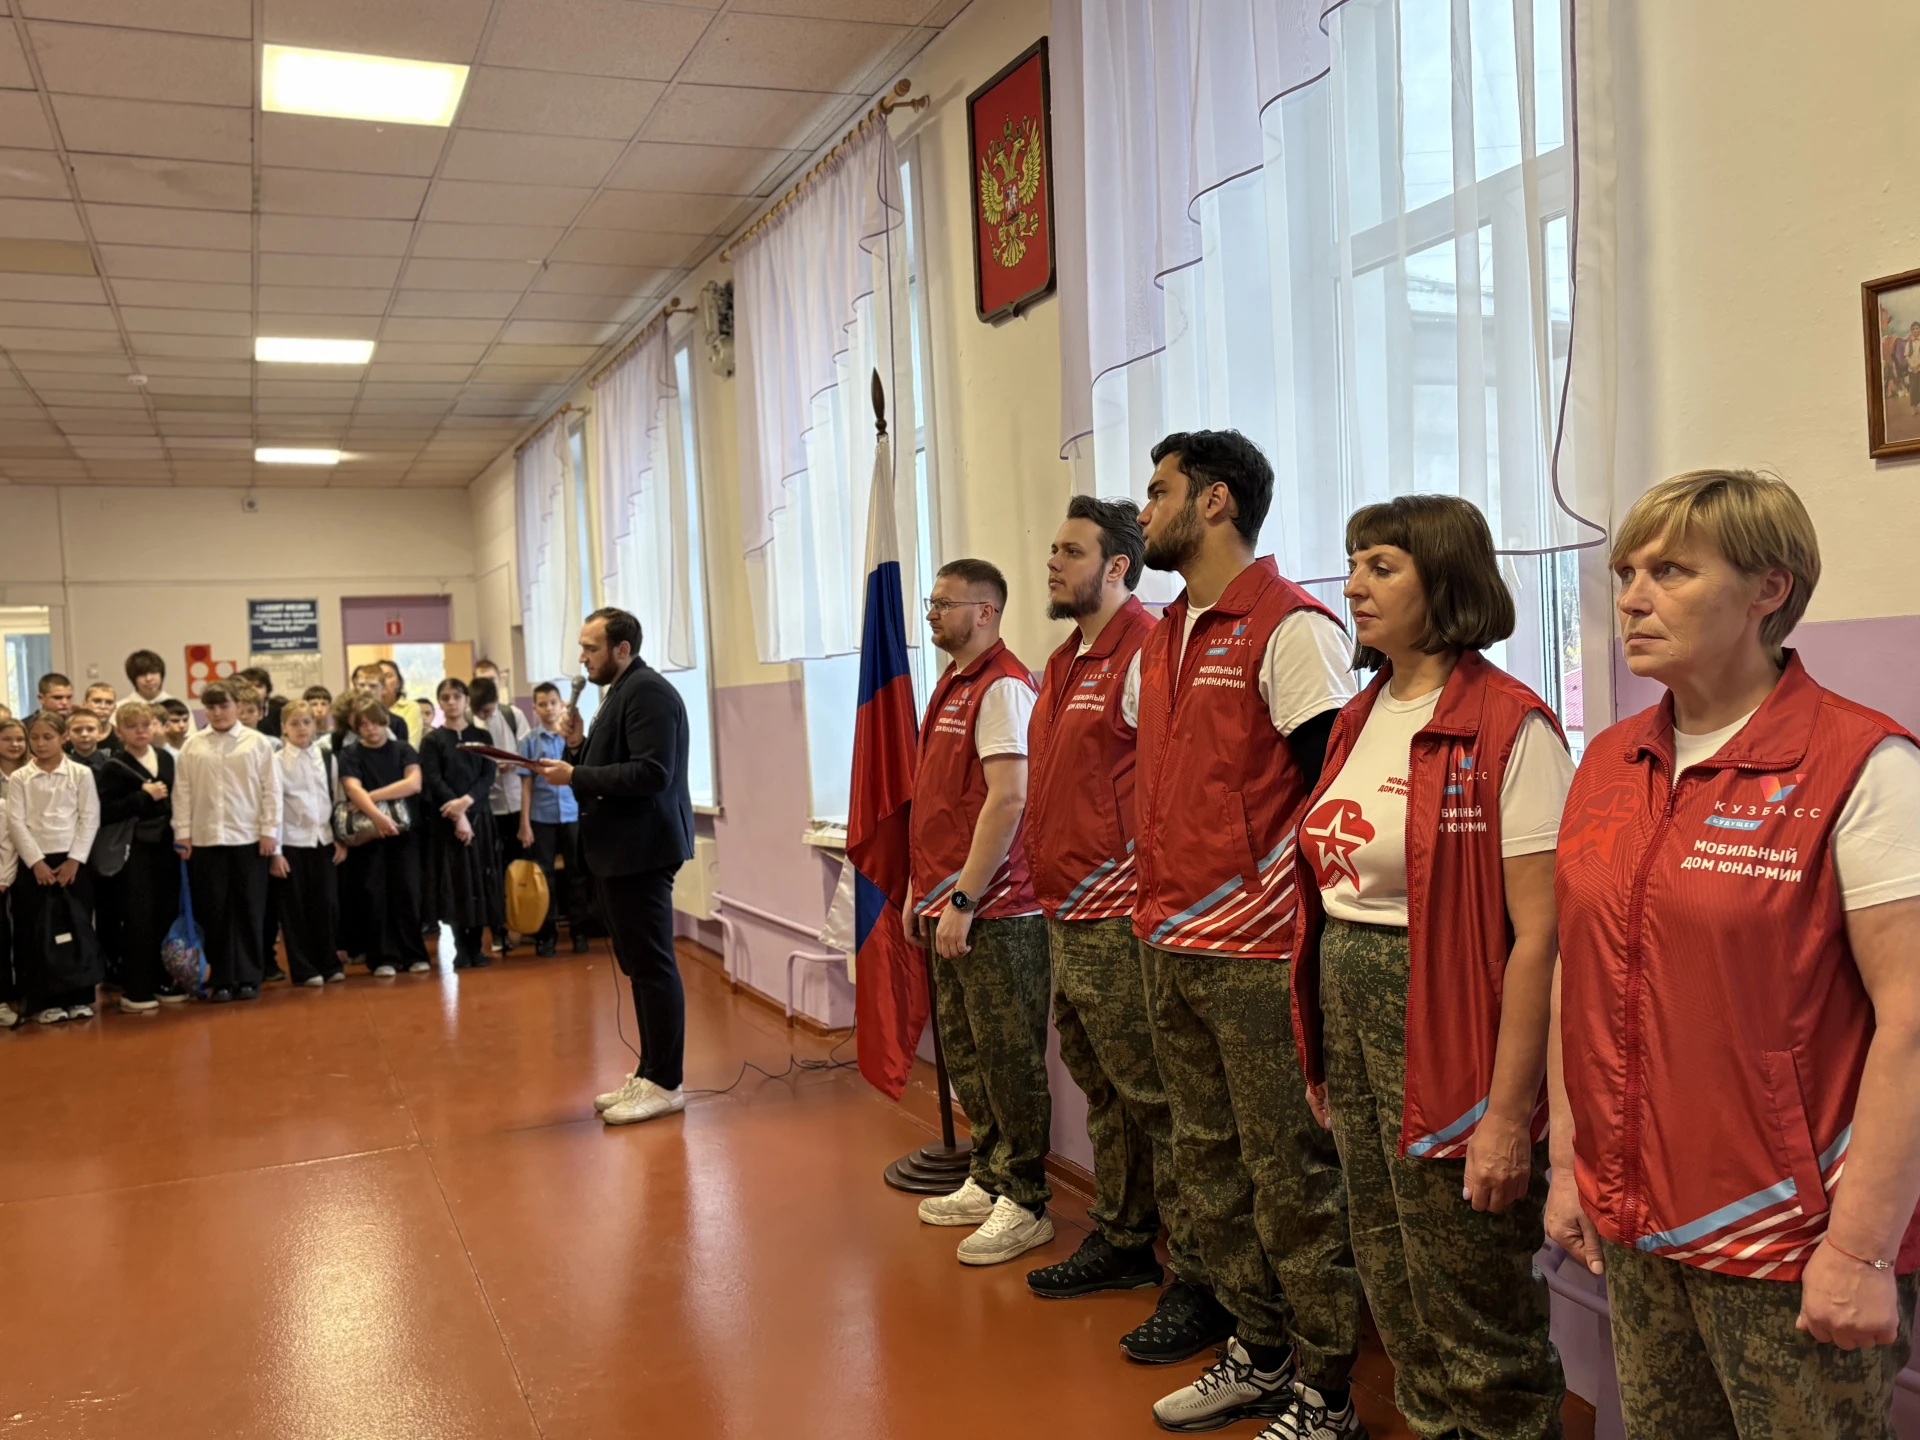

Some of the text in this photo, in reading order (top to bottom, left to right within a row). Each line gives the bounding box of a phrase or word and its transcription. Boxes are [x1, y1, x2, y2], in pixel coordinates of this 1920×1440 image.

[1211, 638, 1253, 646] КУЗБАСС
[1199, 665, 1242, 676] МОБИЛЬНЫЙ
[1206, 677, 1246, 689] ЮНАРМИИ
[1377, 785, 1394, 793] ДОМ
[1714, 800, 1822, 819] КУЗБАСС
[1712, 818, 1755, 828] БУДУЩЕЕ
[1694, 840, 1798, 864] МОБИЛЬНЫЙ
[1681, 856, 1802, 882] ДОМ ЮНАРМИИ
